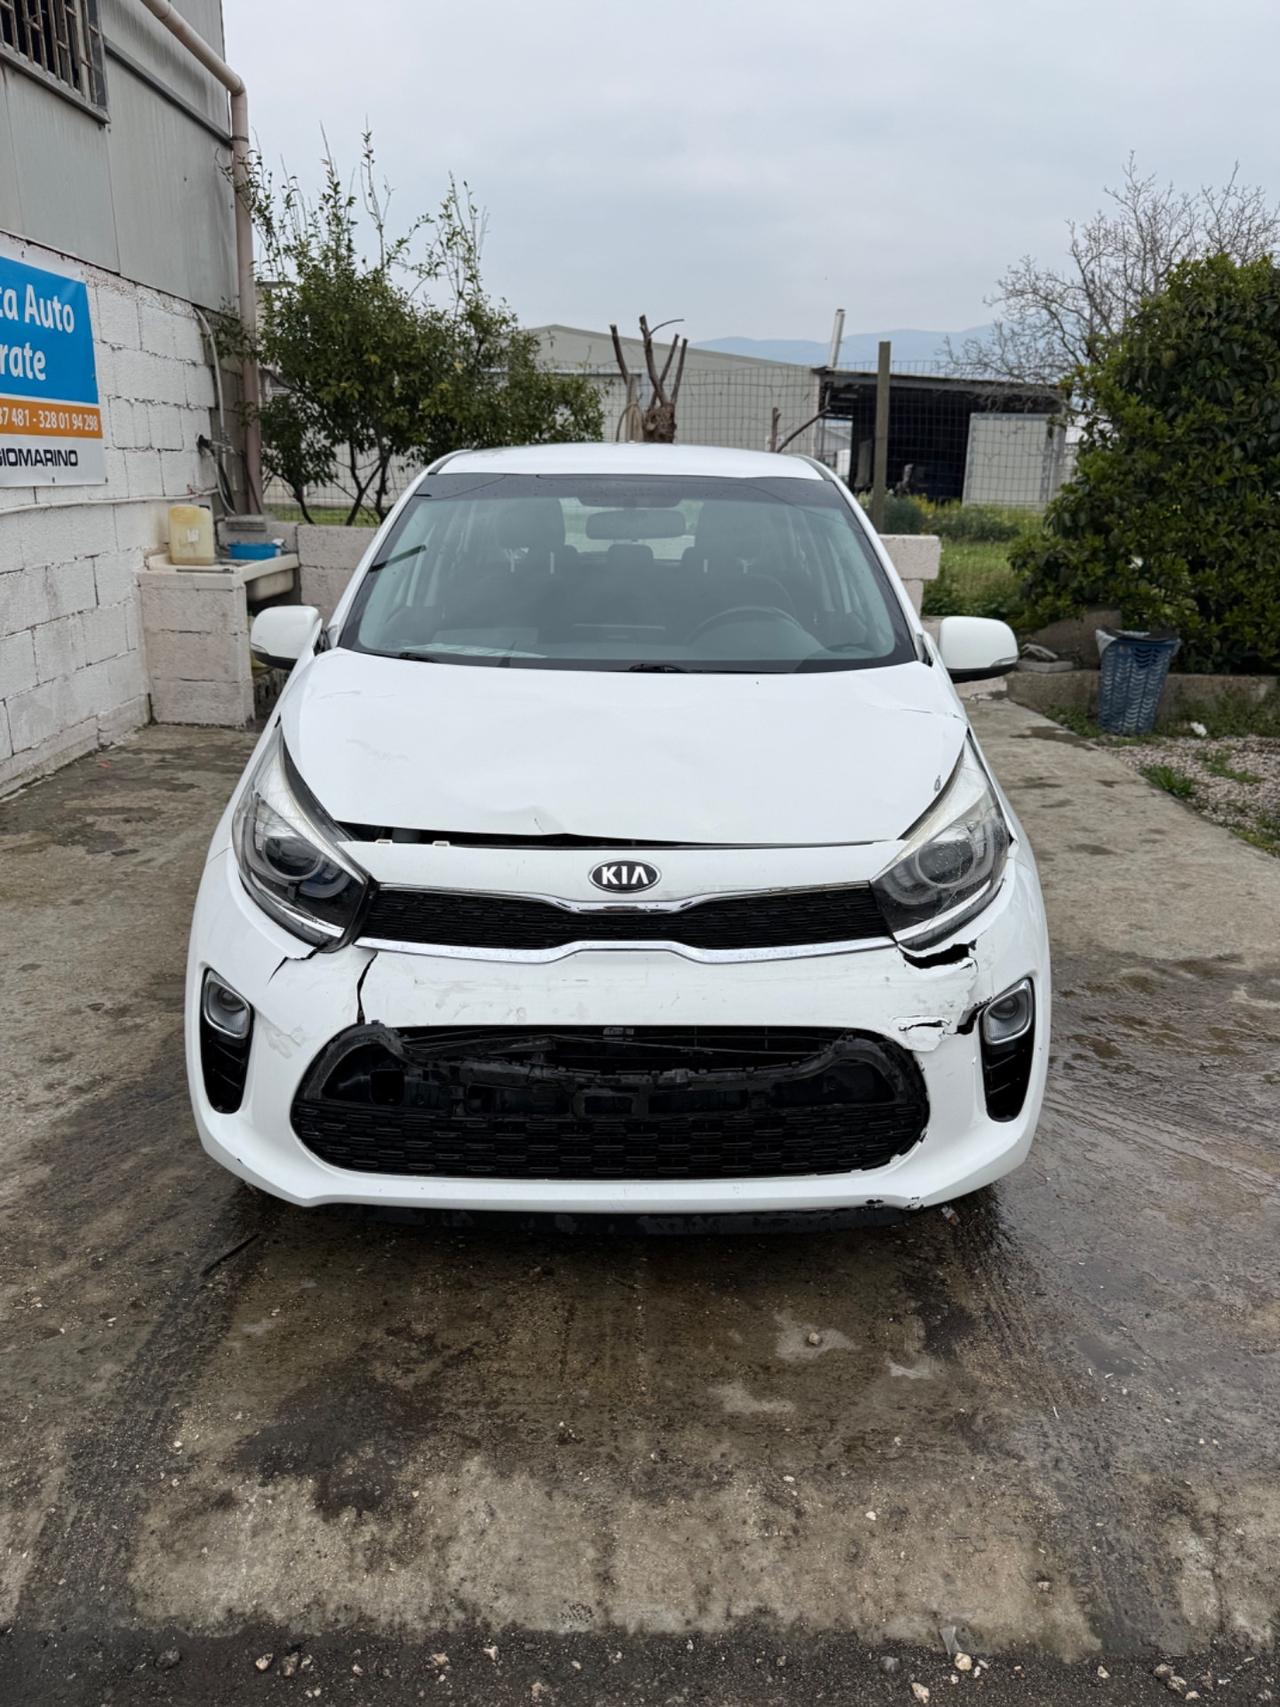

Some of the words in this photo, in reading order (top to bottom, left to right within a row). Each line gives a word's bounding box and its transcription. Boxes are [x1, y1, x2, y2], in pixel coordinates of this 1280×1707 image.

[24, 283, 75, 334] Auto
[11, 408, 30, 427] 481
[38, 410, 57, 429] 328
[59, 412, 70, 430] 01
[0, 448, 79, 467] IOMARINO
[601, 865, 650, 885] KIA
